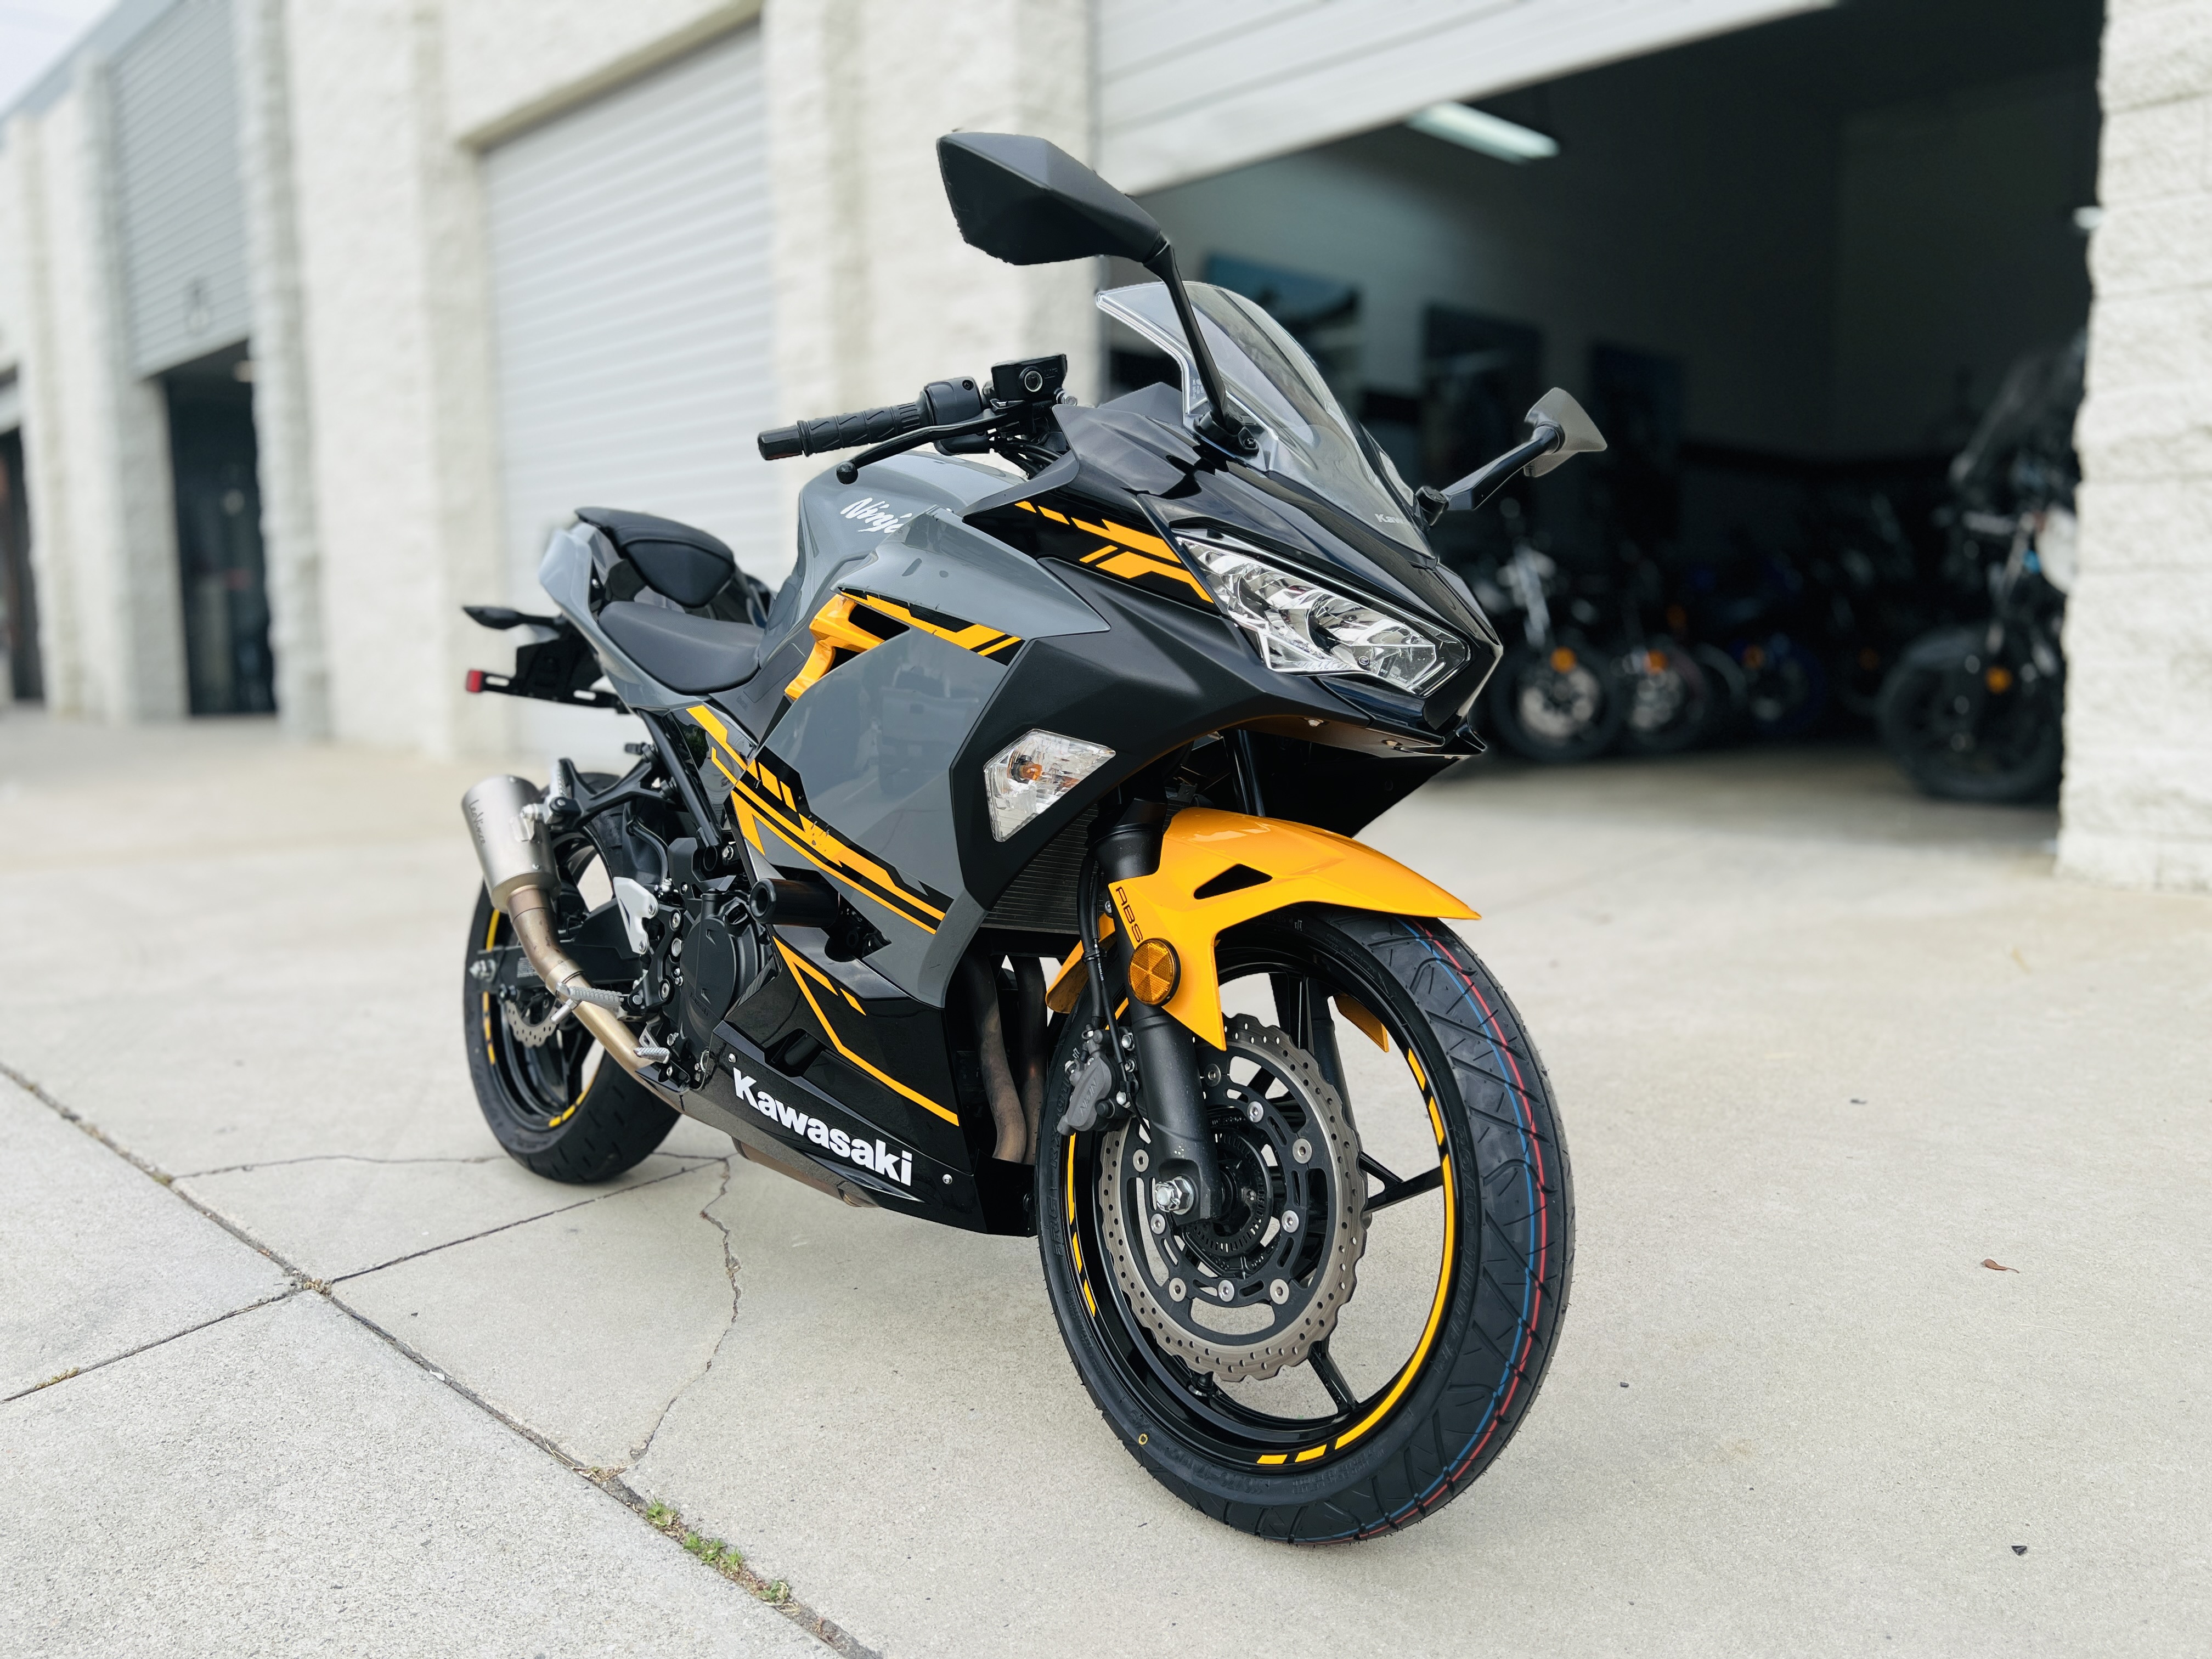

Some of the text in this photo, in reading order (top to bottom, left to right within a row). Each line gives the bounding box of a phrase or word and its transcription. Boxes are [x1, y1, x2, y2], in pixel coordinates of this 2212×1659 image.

[469, 799, 486, 846] LeoVince
[1115, 886, 1143, 943] ABS
[732, 1066, 912, 1187] Kawasaki
